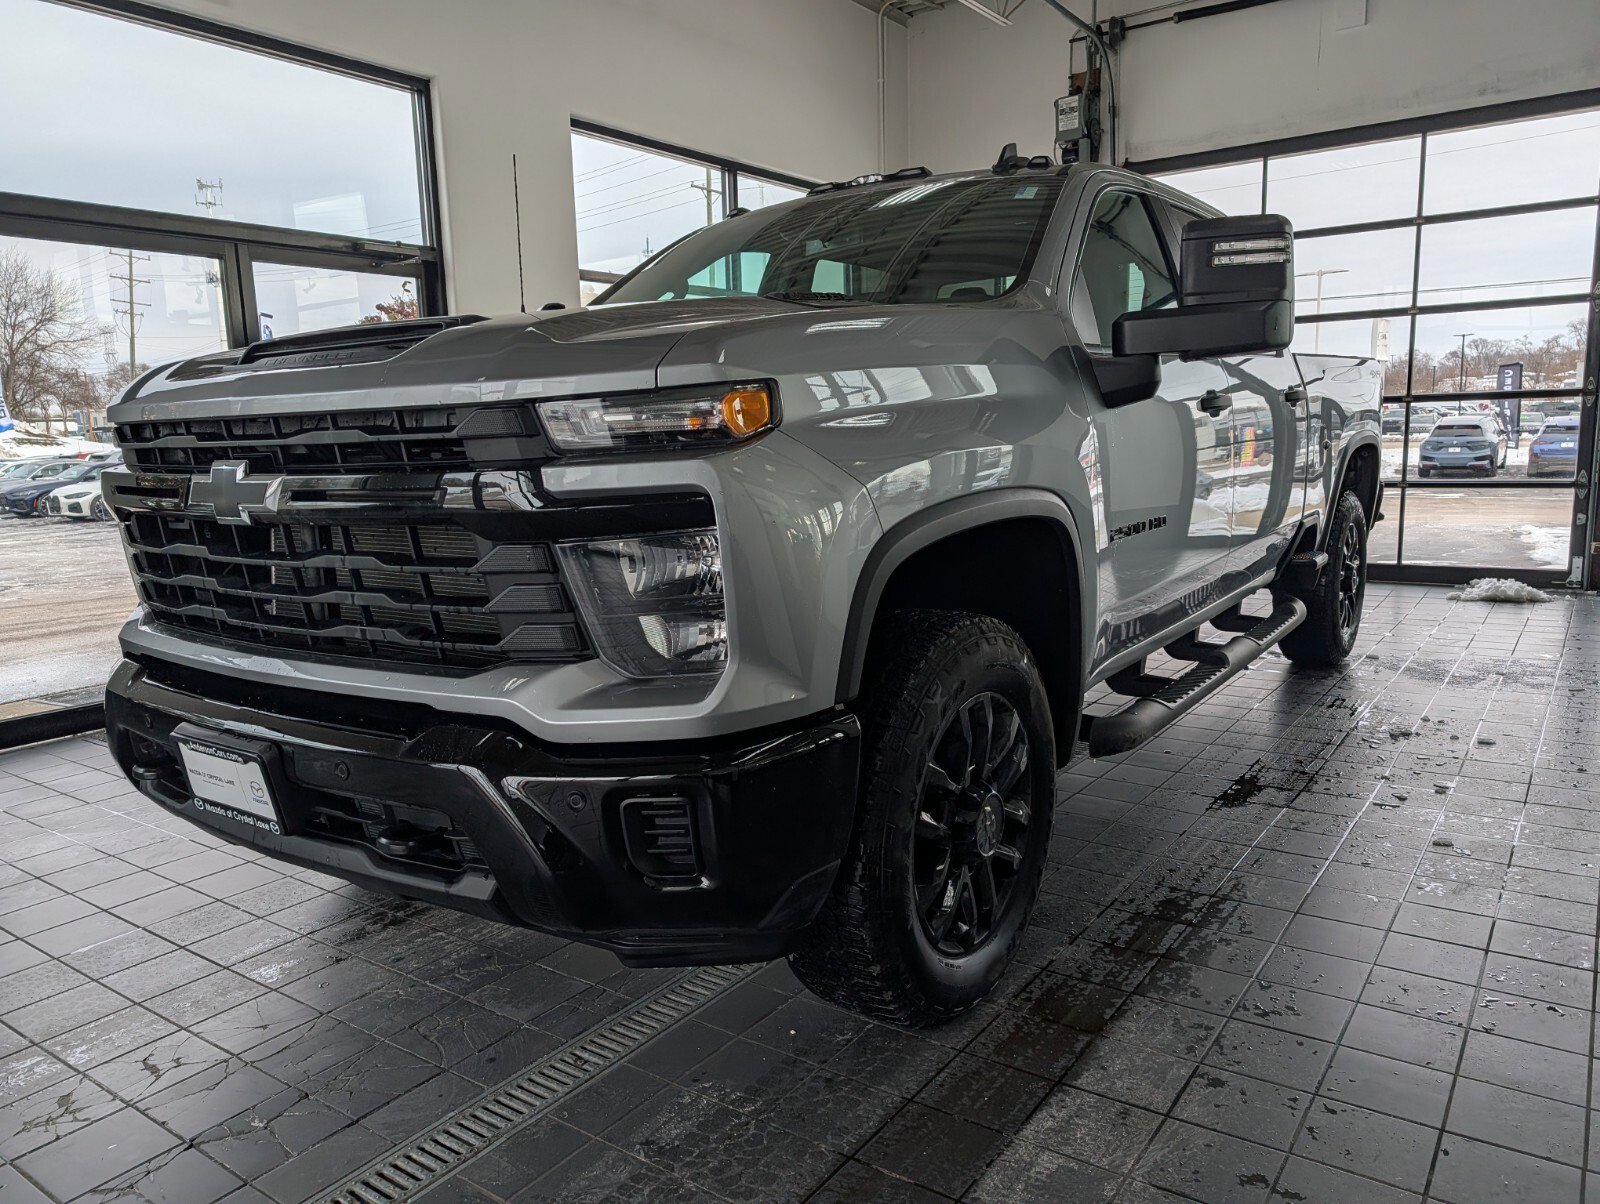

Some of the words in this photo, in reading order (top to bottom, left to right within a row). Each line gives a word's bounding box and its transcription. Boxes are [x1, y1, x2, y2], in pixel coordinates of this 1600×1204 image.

[1148, 515, 1167, 531] HD
[204, 802, 226, 817] Mazda
[233, 811, 254, 826] Crystal
[254, 818, 270, 831] Lake
